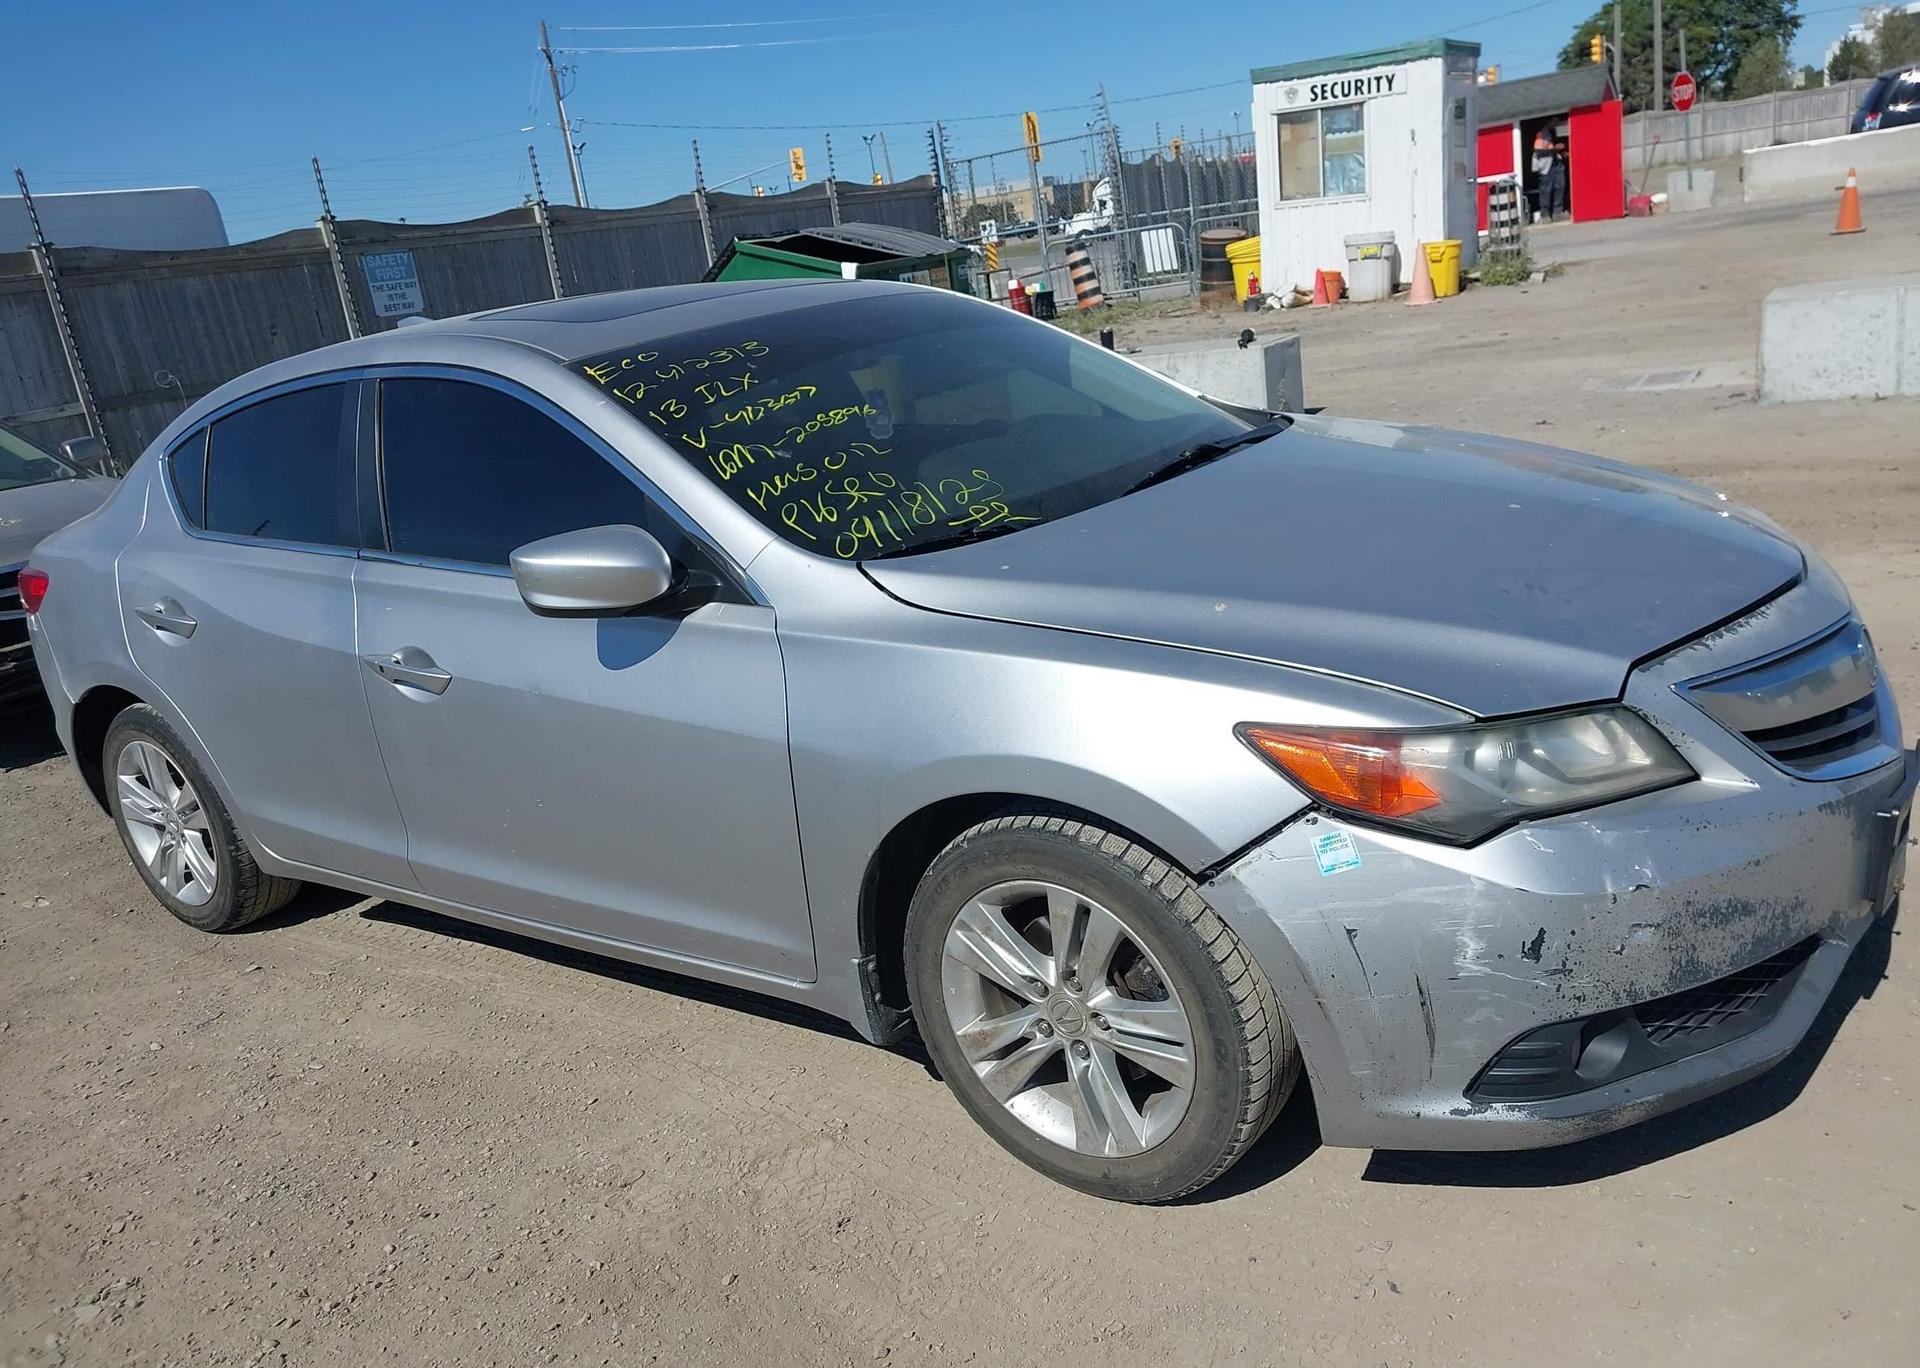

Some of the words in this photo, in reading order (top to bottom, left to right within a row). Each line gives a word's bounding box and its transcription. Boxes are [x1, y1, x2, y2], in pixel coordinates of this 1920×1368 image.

[1310, 73, 1395, 102] SECURITY
[1673, 83, 1694, 102] STOP
[366, 252, 409, 267] SAFETY
[376, 266, 407, 280] FIRST
[372, 284, 385, 293] THE
[386, 283, 402, 291] SAFE
[404, 281, 417, 289] WAY
[387, 293, 394, 302] IS
[395, 292, 408, 301] THE
[384, 303, 401, 313] BEST
[402, 302, 415, 311] WAY
[649, 399, 688, 425] 13
[1318, 837, 1348, 849] REPORTED
[1319, 832, 1341, 843] DAMAGE
[1329, 843, 1349, 852] POLICE
